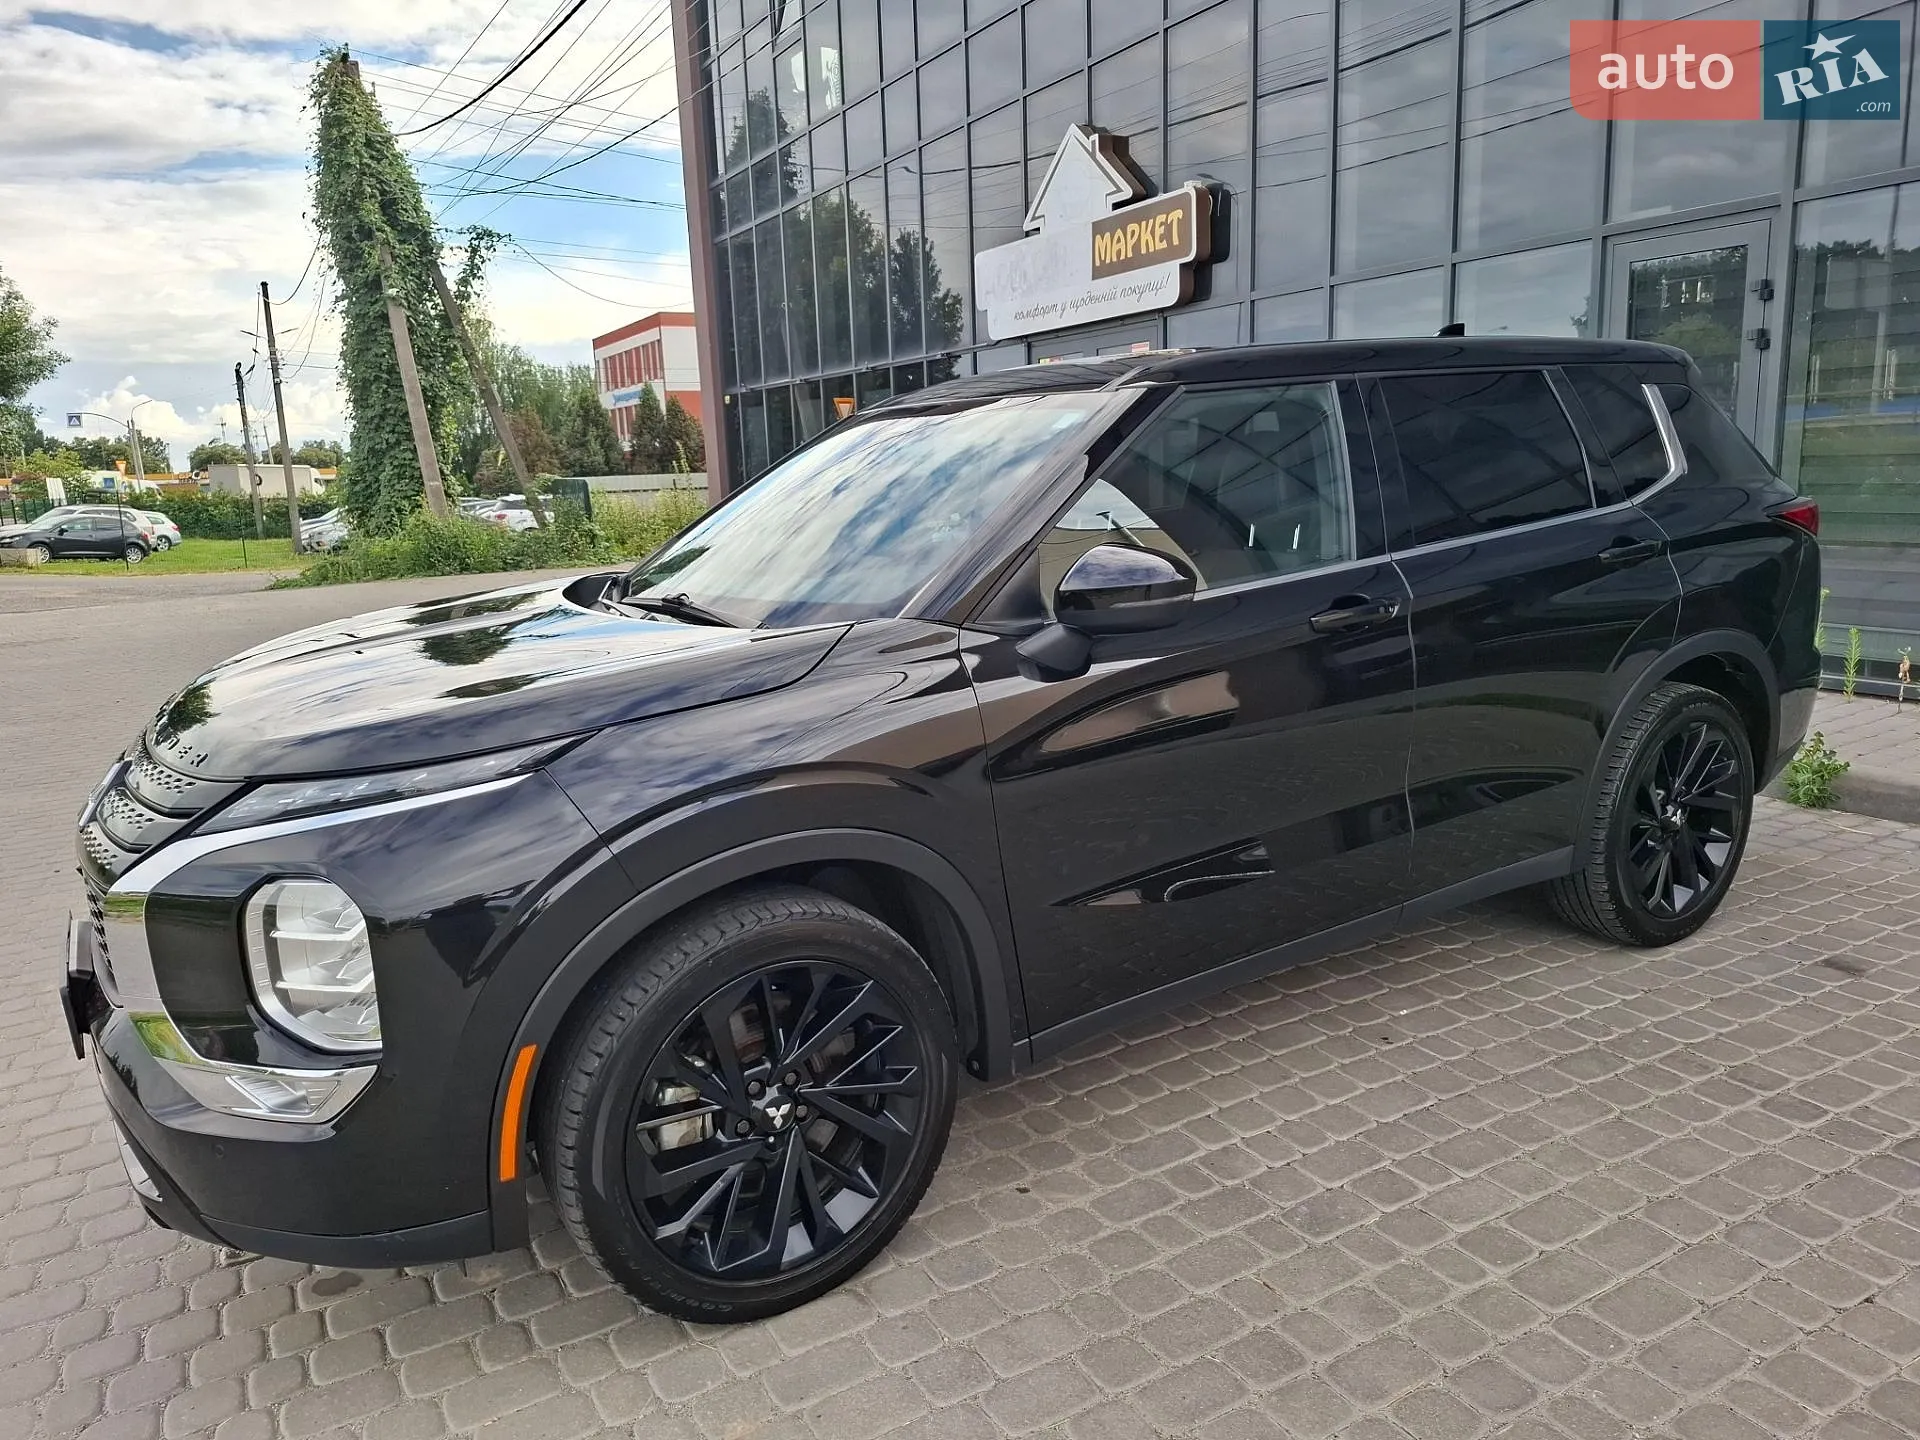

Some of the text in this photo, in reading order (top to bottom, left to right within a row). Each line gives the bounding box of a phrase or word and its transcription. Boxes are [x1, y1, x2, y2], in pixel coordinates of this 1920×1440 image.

[1095, 209, 1183, 267] МАРКЕТ
[1014, 271, 1171, 320] комфорт у щоденній покупці!
